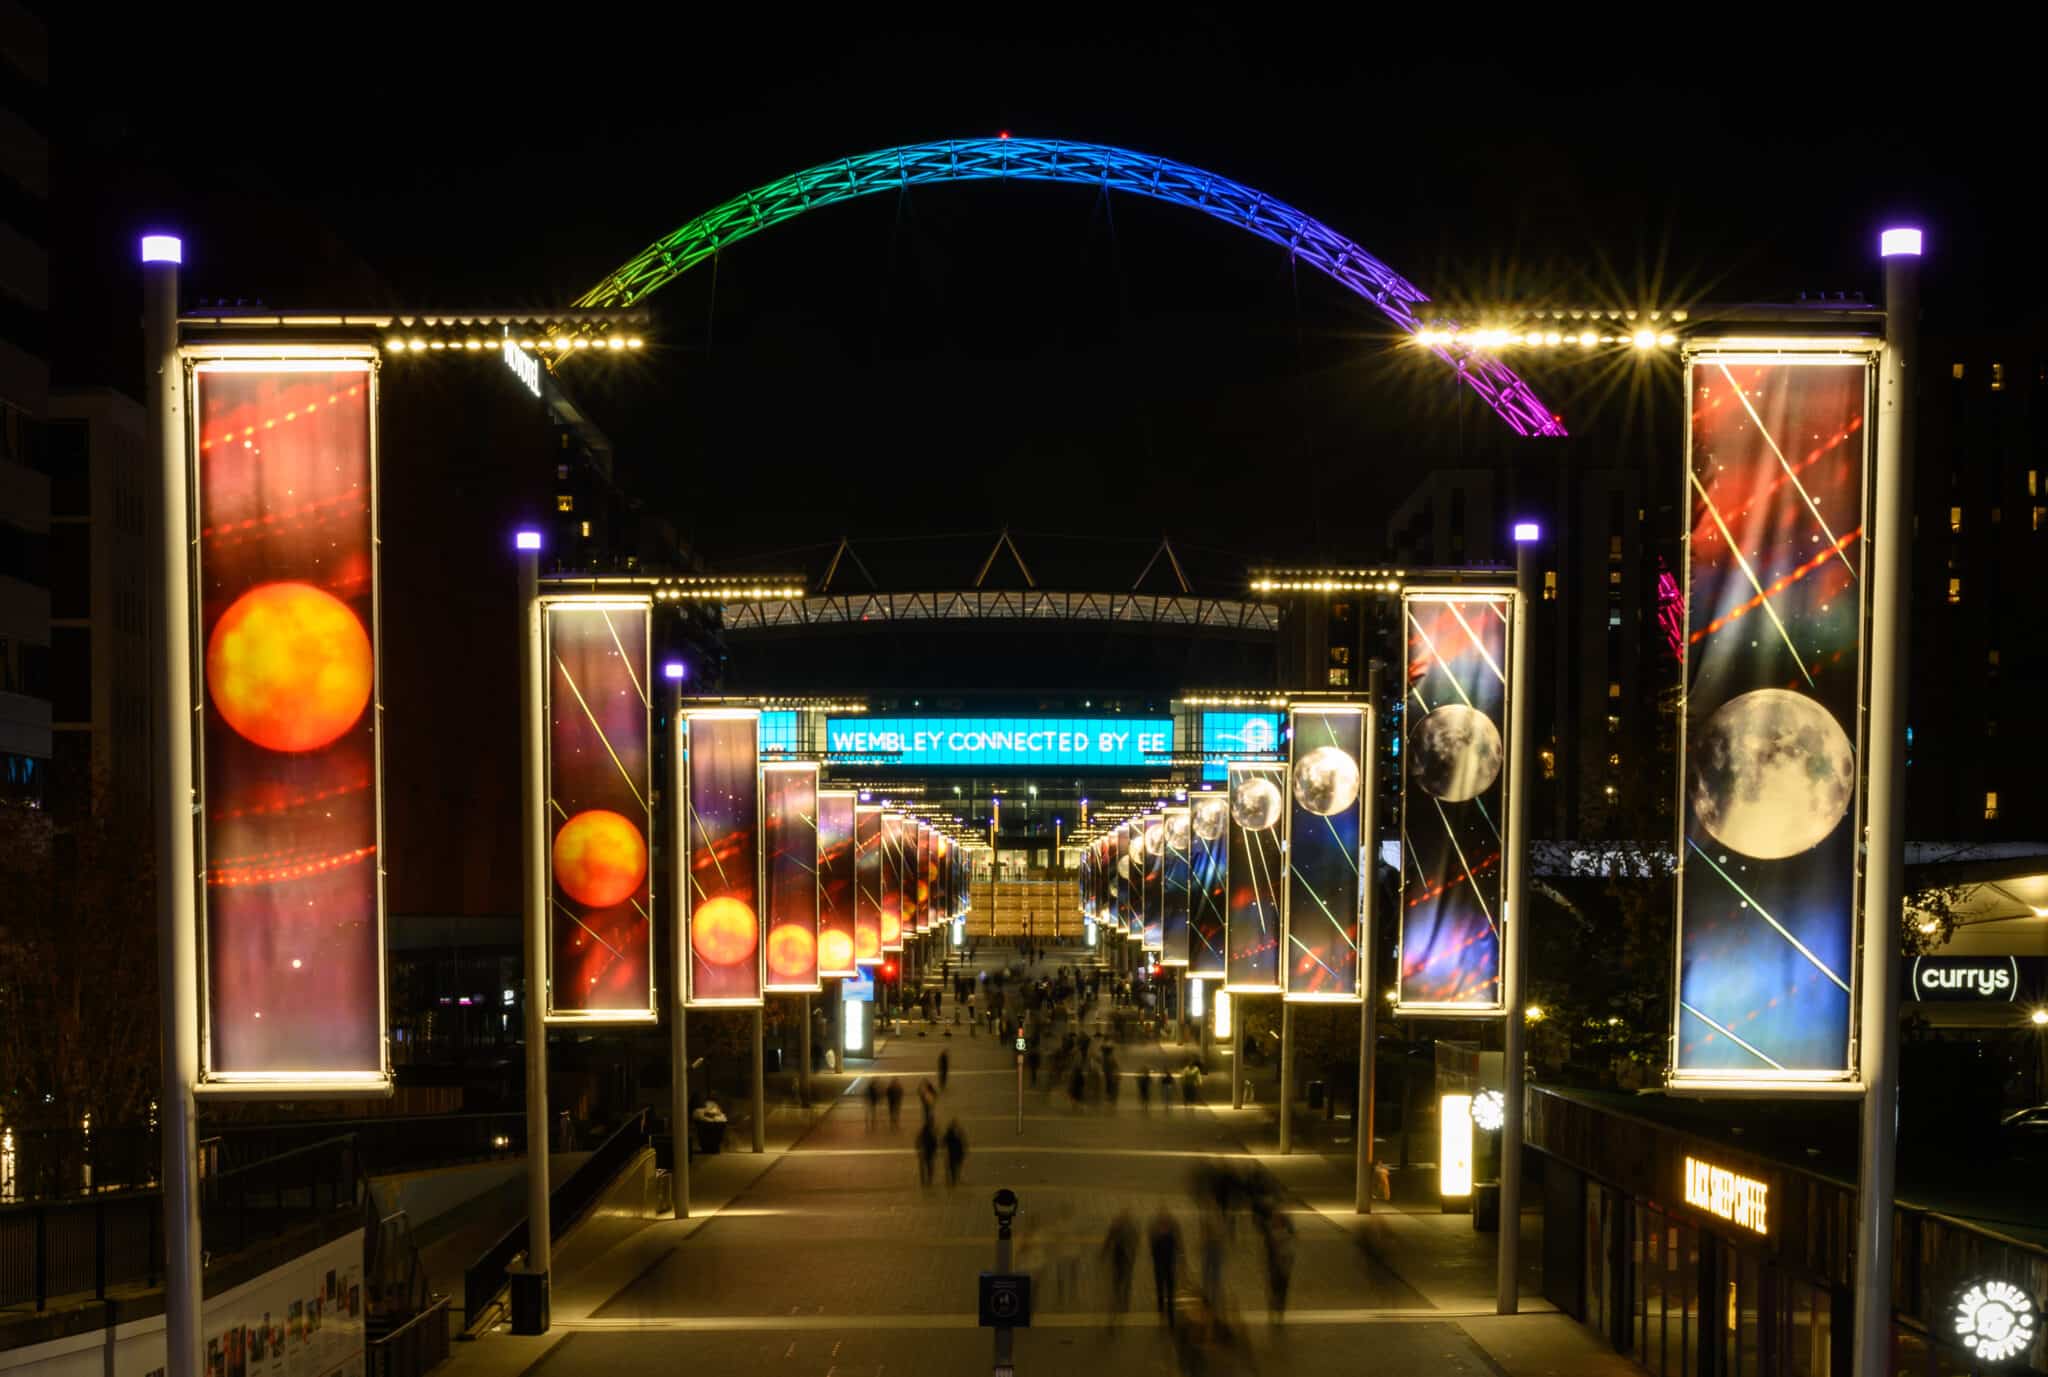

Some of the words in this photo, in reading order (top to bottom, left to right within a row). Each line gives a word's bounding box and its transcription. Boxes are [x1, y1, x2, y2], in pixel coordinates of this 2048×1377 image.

[832, 731, 944, 752] WEMBLEY
[948, 731, 1089, 752] CONNECTED
[1099, 732, 1129, 752] BY
[1137, 733, 1166, 752] EE
[1921, 968, 2010, 995] currys
[1684, 1156, 1710, 1212] BLACK
[1710, 1165, 1735, 1220] SHEEP
[1735, 1174, 1768, 1234] COFFEE
